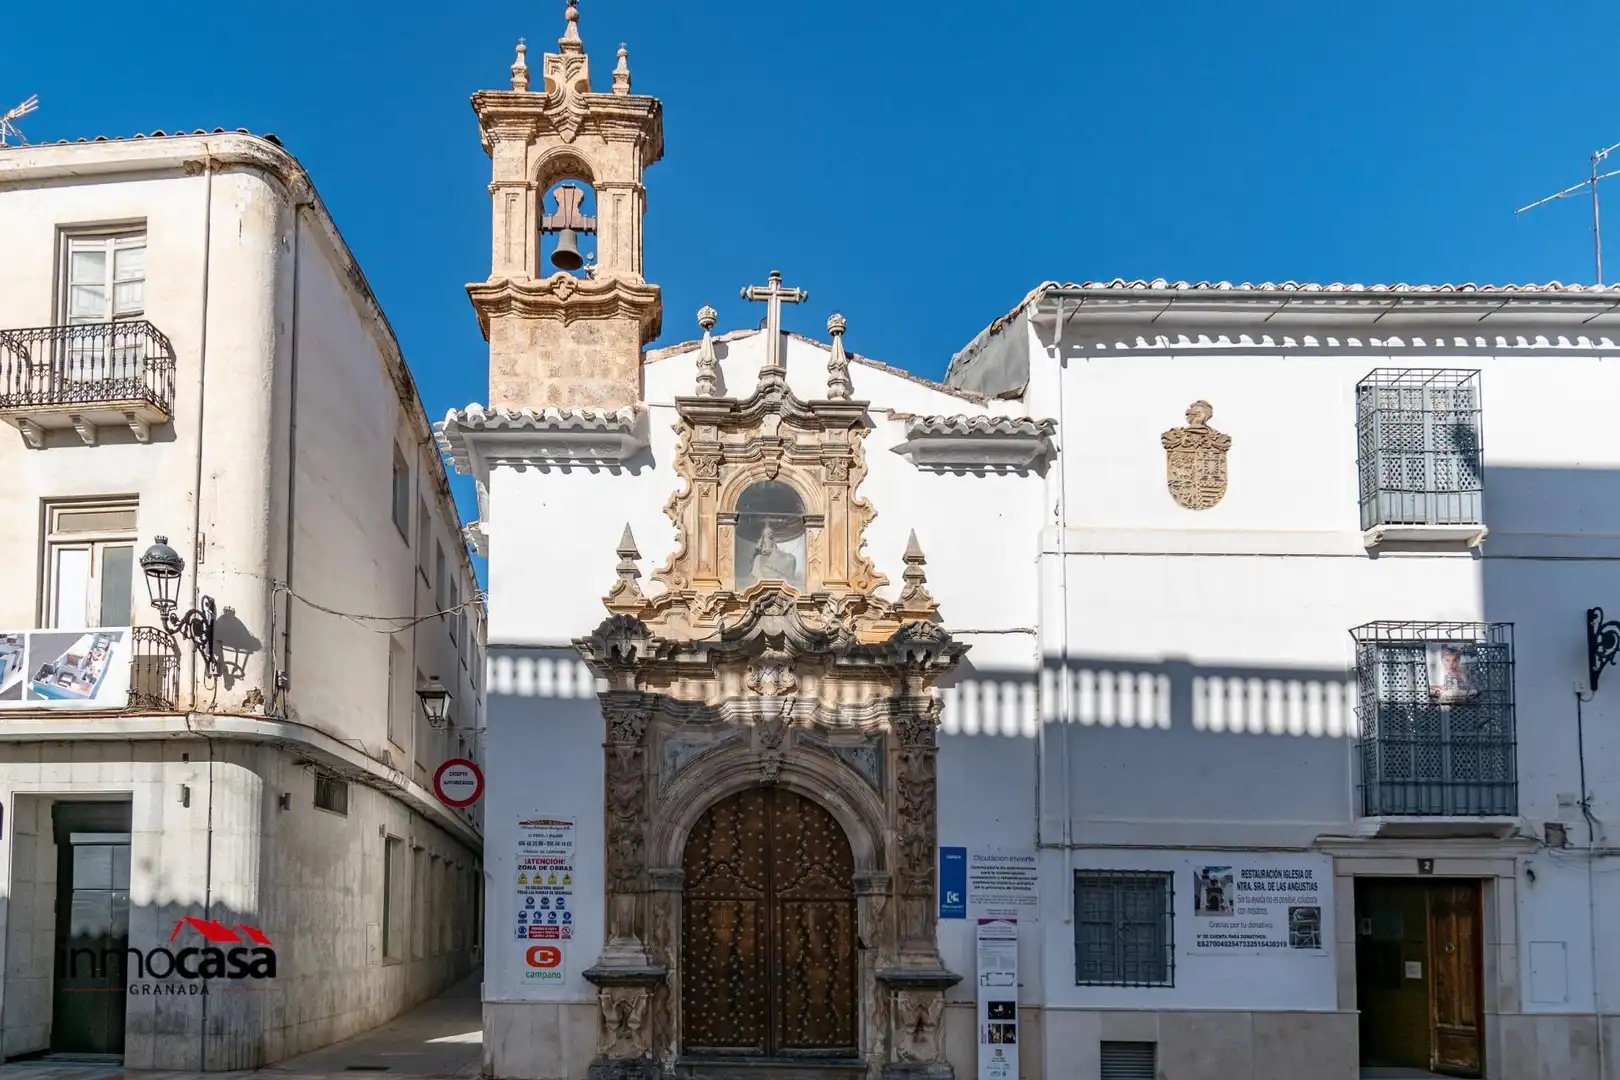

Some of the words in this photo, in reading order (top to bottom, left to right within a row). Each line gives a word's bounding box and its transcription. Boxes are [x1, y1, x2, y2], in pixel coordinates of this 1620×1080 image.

[1423, 861, 1431, 870] 2
[1241, 868, 1282, 879] RESTAURACIÓN
[1282, 869, 1304, 879] IGLESIA
[1304, 869, 1313, 879] DE
[1236, 881, 1252, 891] NTRA.
[1253, 881, 1266, 891] SRA.
[1267, 881, 1276, 891] DE
[1276, 881, 1287, 891] LAS
[1287, 882, 1318, 892] ANGUSTIAS
[1237, 894, 1245, 904] Sin
[1245, 895, 1251, 904] tu
[1251, 895, 1265, 906] ayuda
[1297, 895, 1318, 904] colabora
[1208, 920, 1229, 929] Gracias
[1229, 922, 1239, 930] por
[1240, 921, 1247, 929] tu
[525, 971, 562, 980] campano
